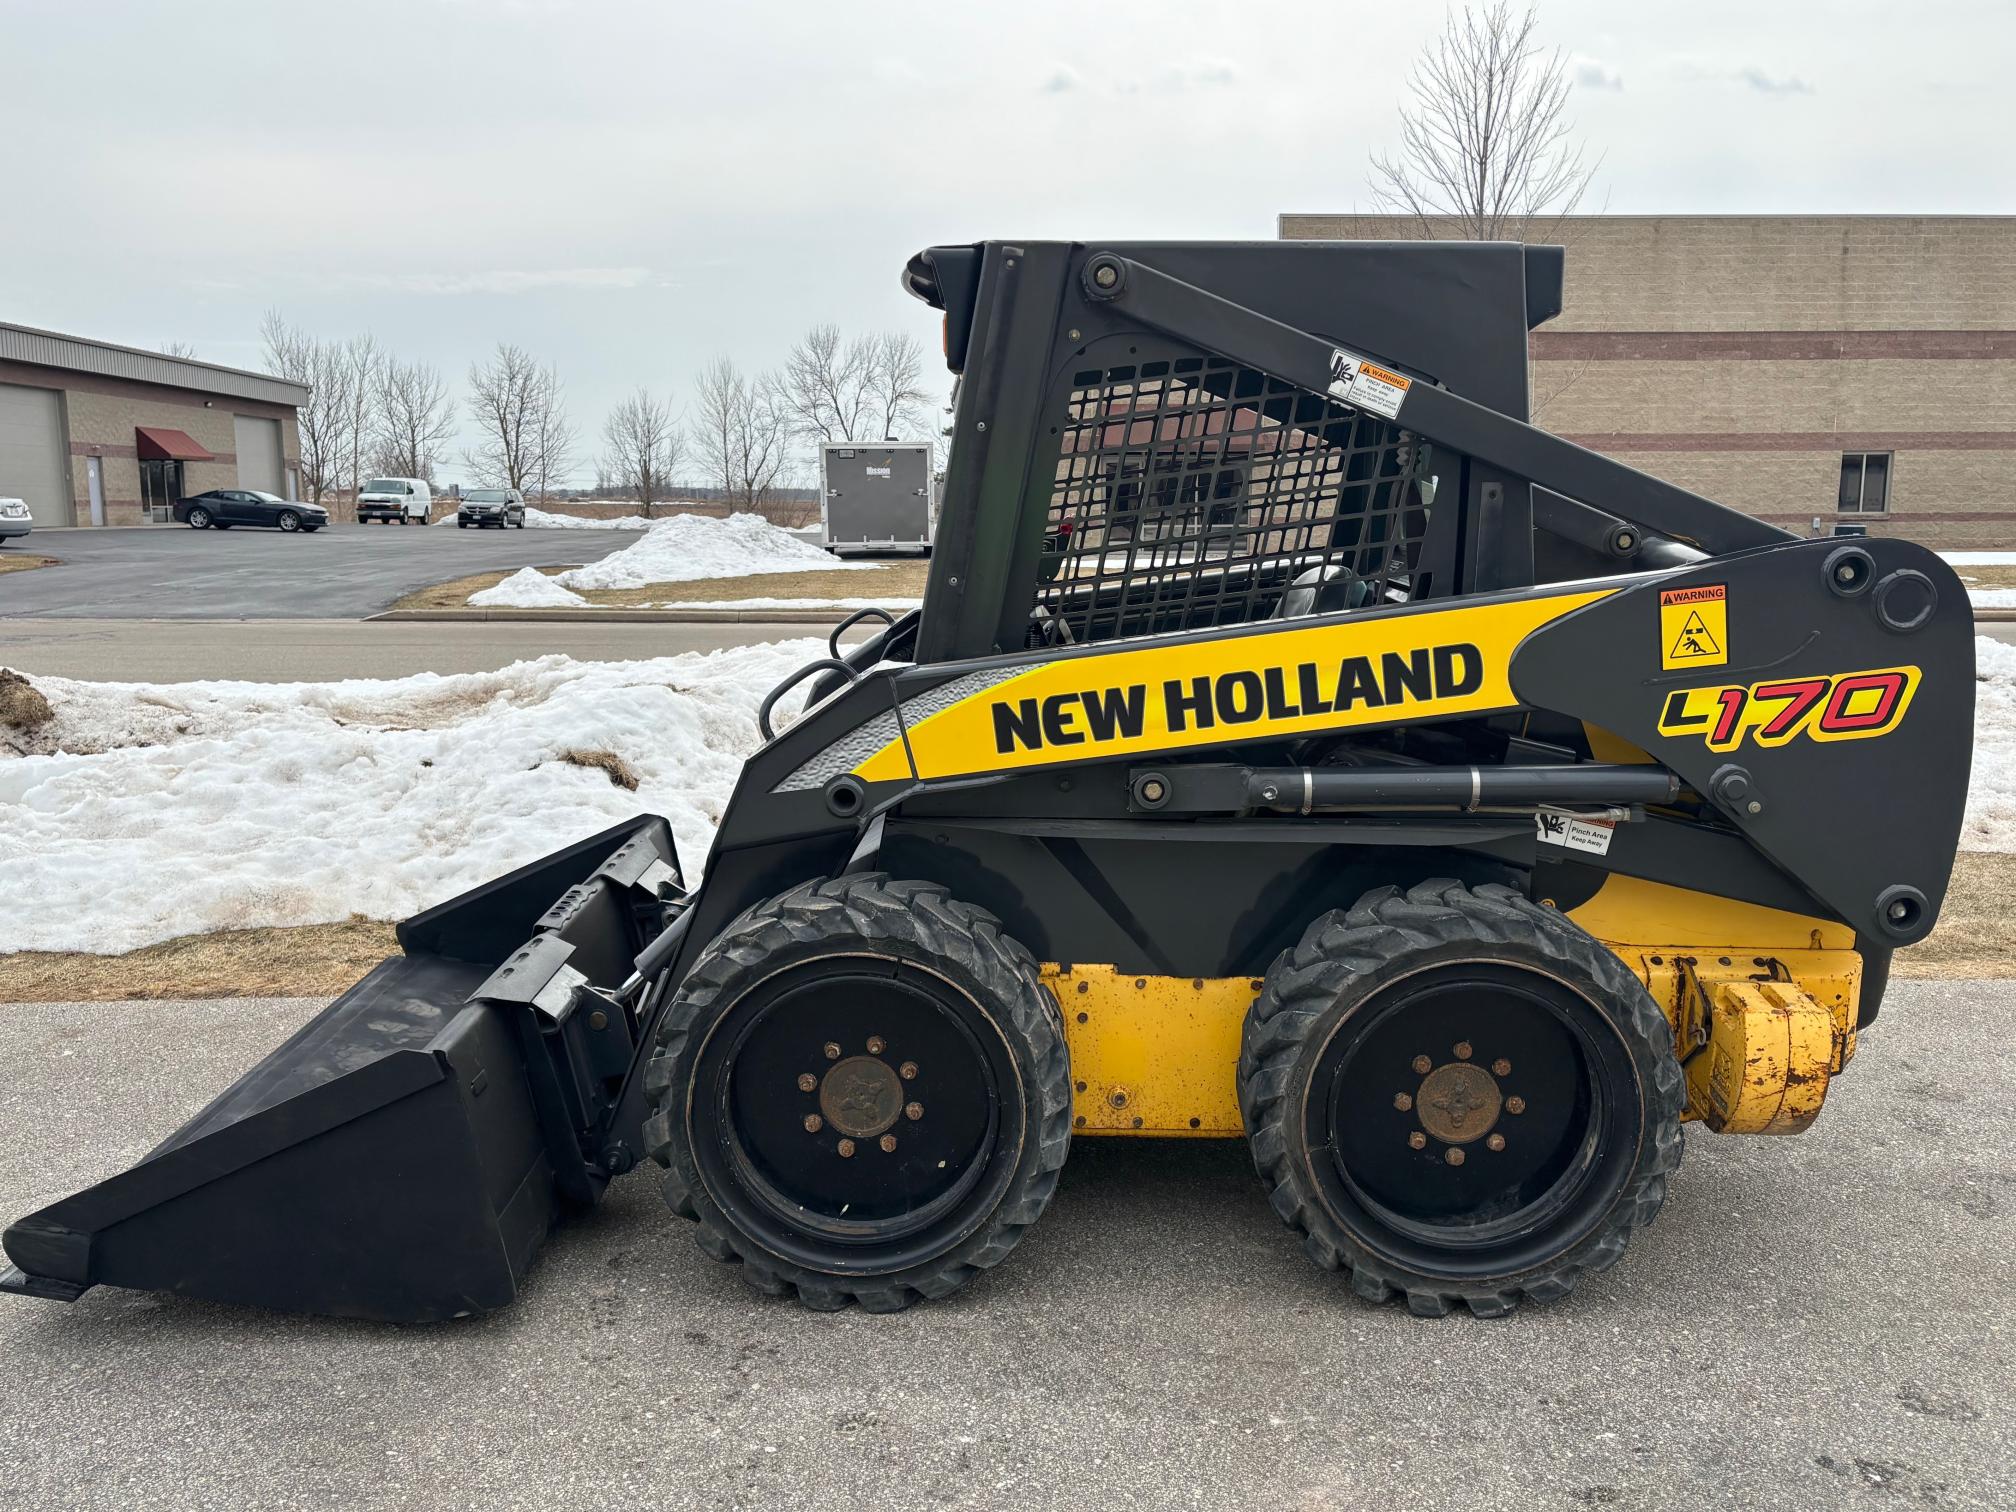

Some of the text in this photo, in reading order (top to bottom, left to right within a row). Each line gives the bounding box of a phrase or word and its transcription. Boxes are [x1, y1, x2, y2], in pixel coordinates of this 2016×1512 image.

[1366, 378, 1381, 386] PINCH
[1372, 369, 1405, 387] WARNING
[1673, 588, 1724, 602] WARNING
[991, 643, 1484, 754] NEW HOLLAND
[1659, 669, 1914, 749] L170
[1571, 827, 1608, 840] Pinch Area
[1587, 839, 1603, 848] Away
